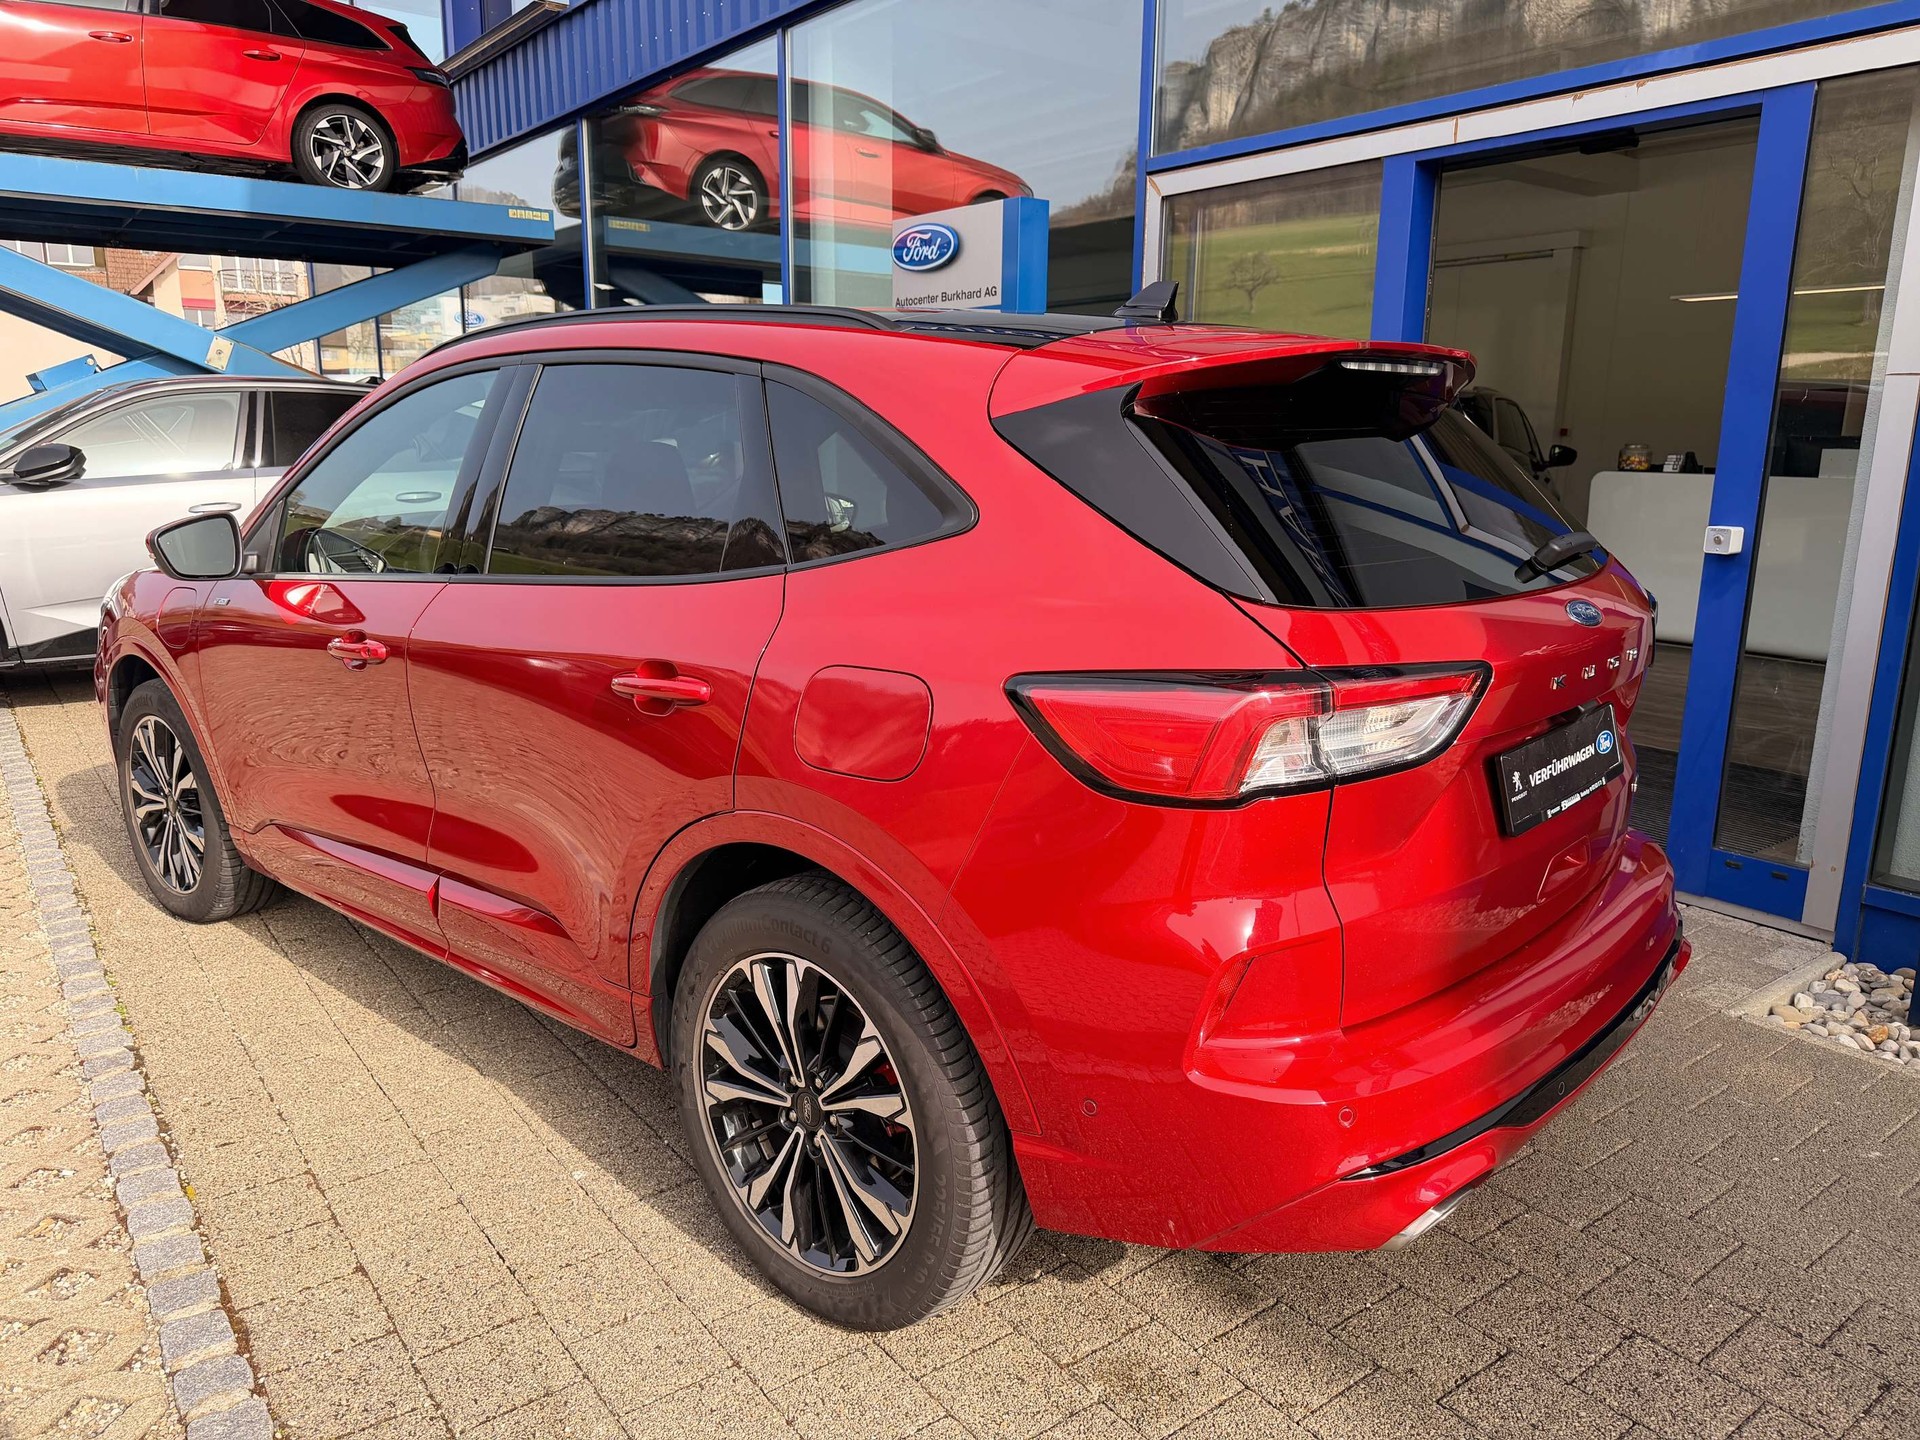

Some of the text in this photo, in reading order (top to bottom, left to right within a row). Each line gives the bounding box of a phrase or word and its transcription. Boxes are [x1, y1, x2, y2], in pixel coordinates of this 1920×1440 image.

[902, 231, 941, 263] Ford
[895, 286, 997, 308] Autocenter Burkhard AG
[1529, 743, 1595, 787] VERFÜHRWAGEN
